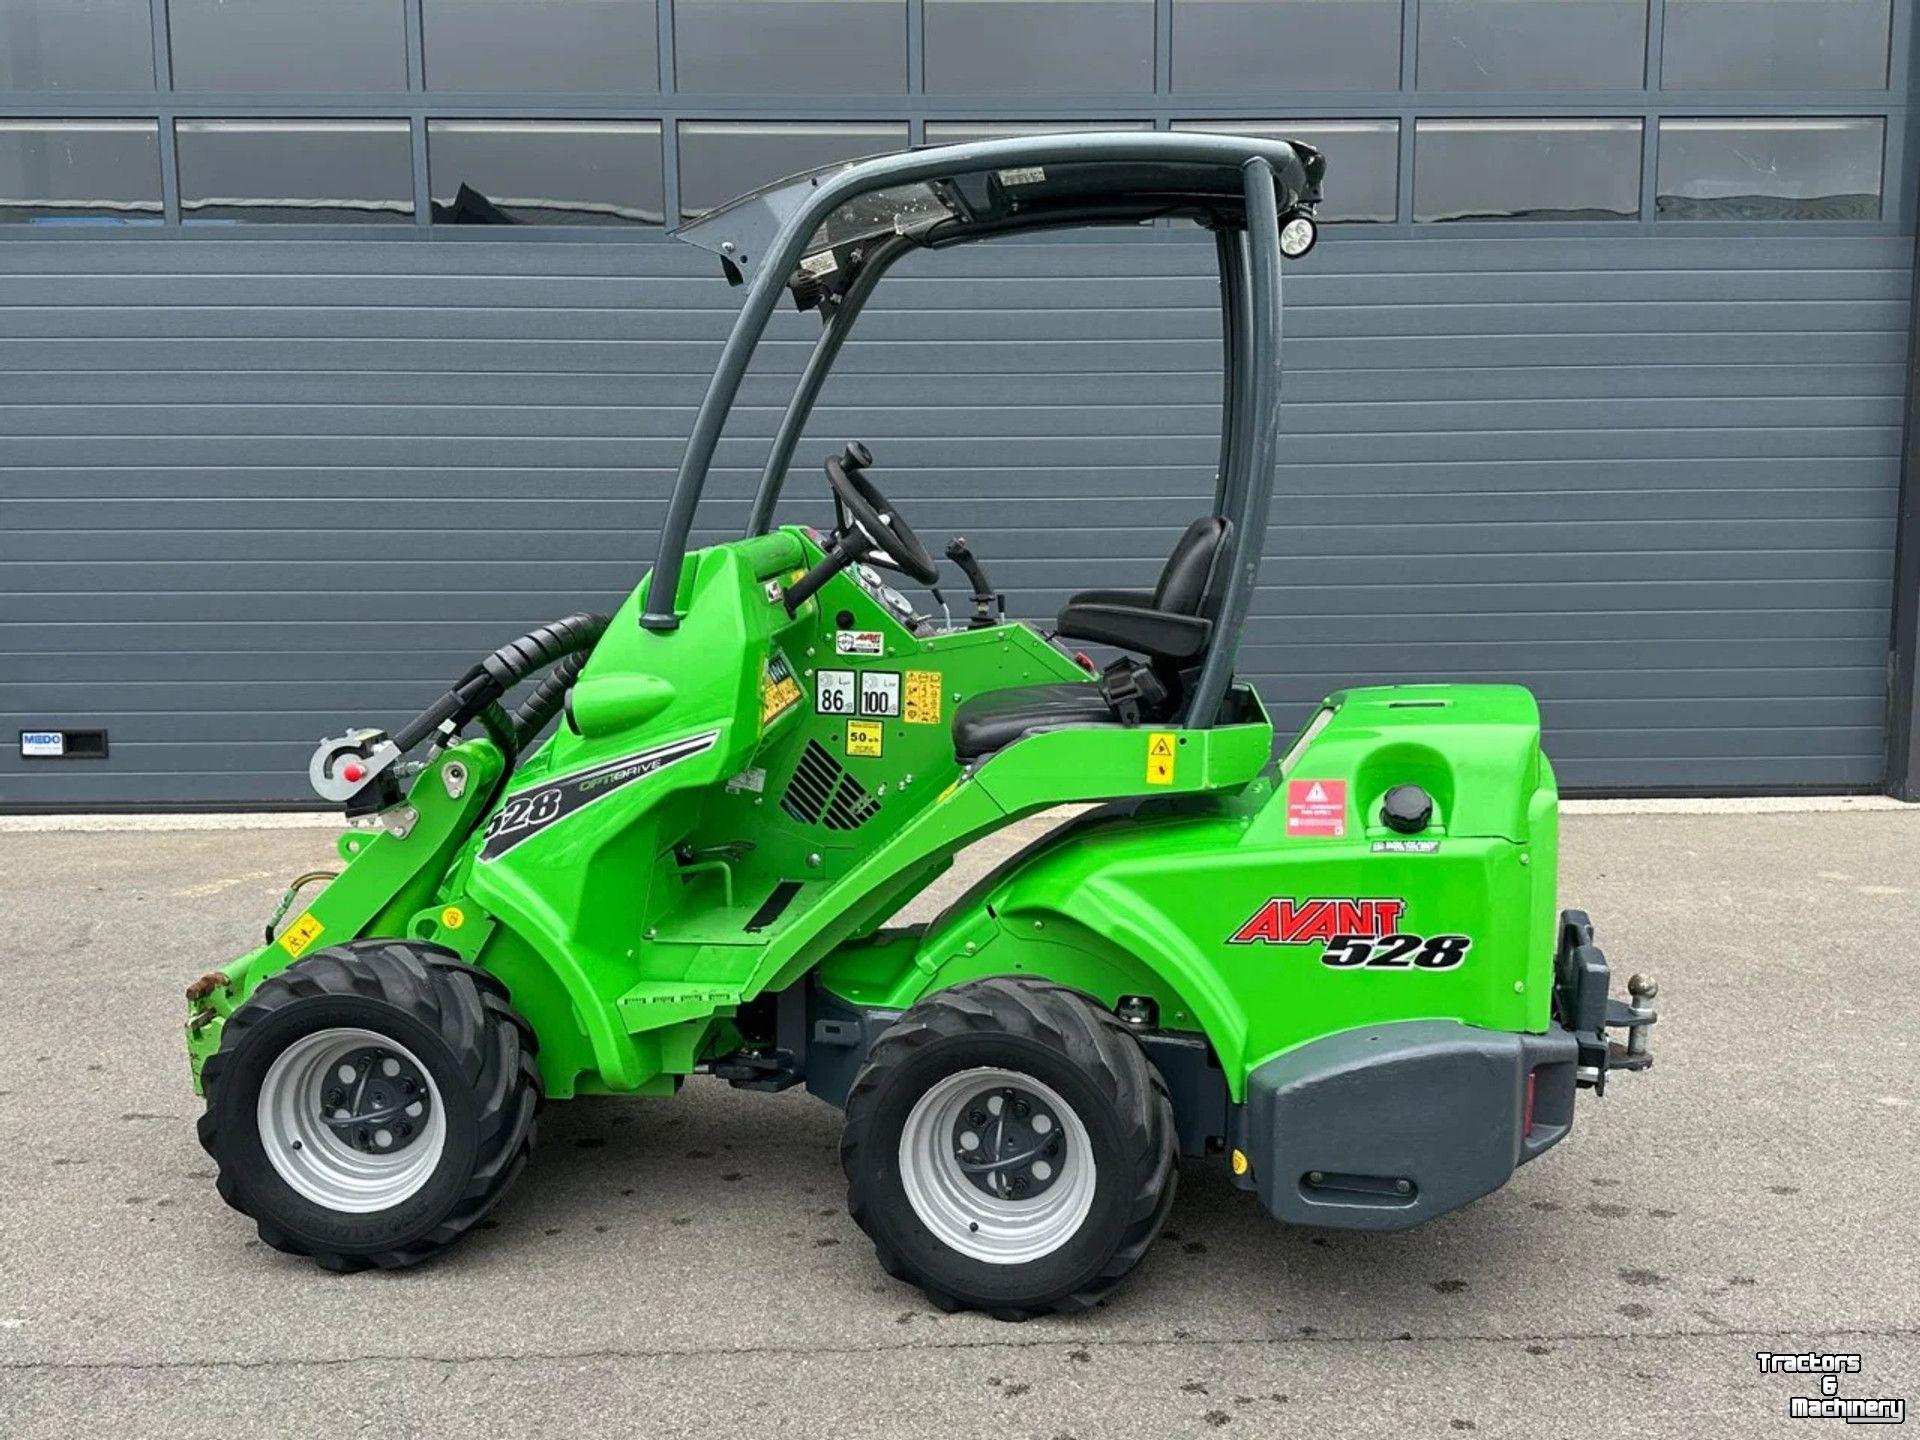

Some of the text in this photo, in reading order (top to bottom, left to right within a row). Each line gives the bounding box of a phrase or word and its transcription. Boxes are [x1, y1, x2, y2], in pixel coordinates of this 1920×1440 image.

[822, 689, 844, 711] 86
[864, 691, 889, 713] 100
[850, 732, 867, 742] 50
[1225, 897, 1406, 945] AVANT
[1320, 934, 1472, 971] 528
